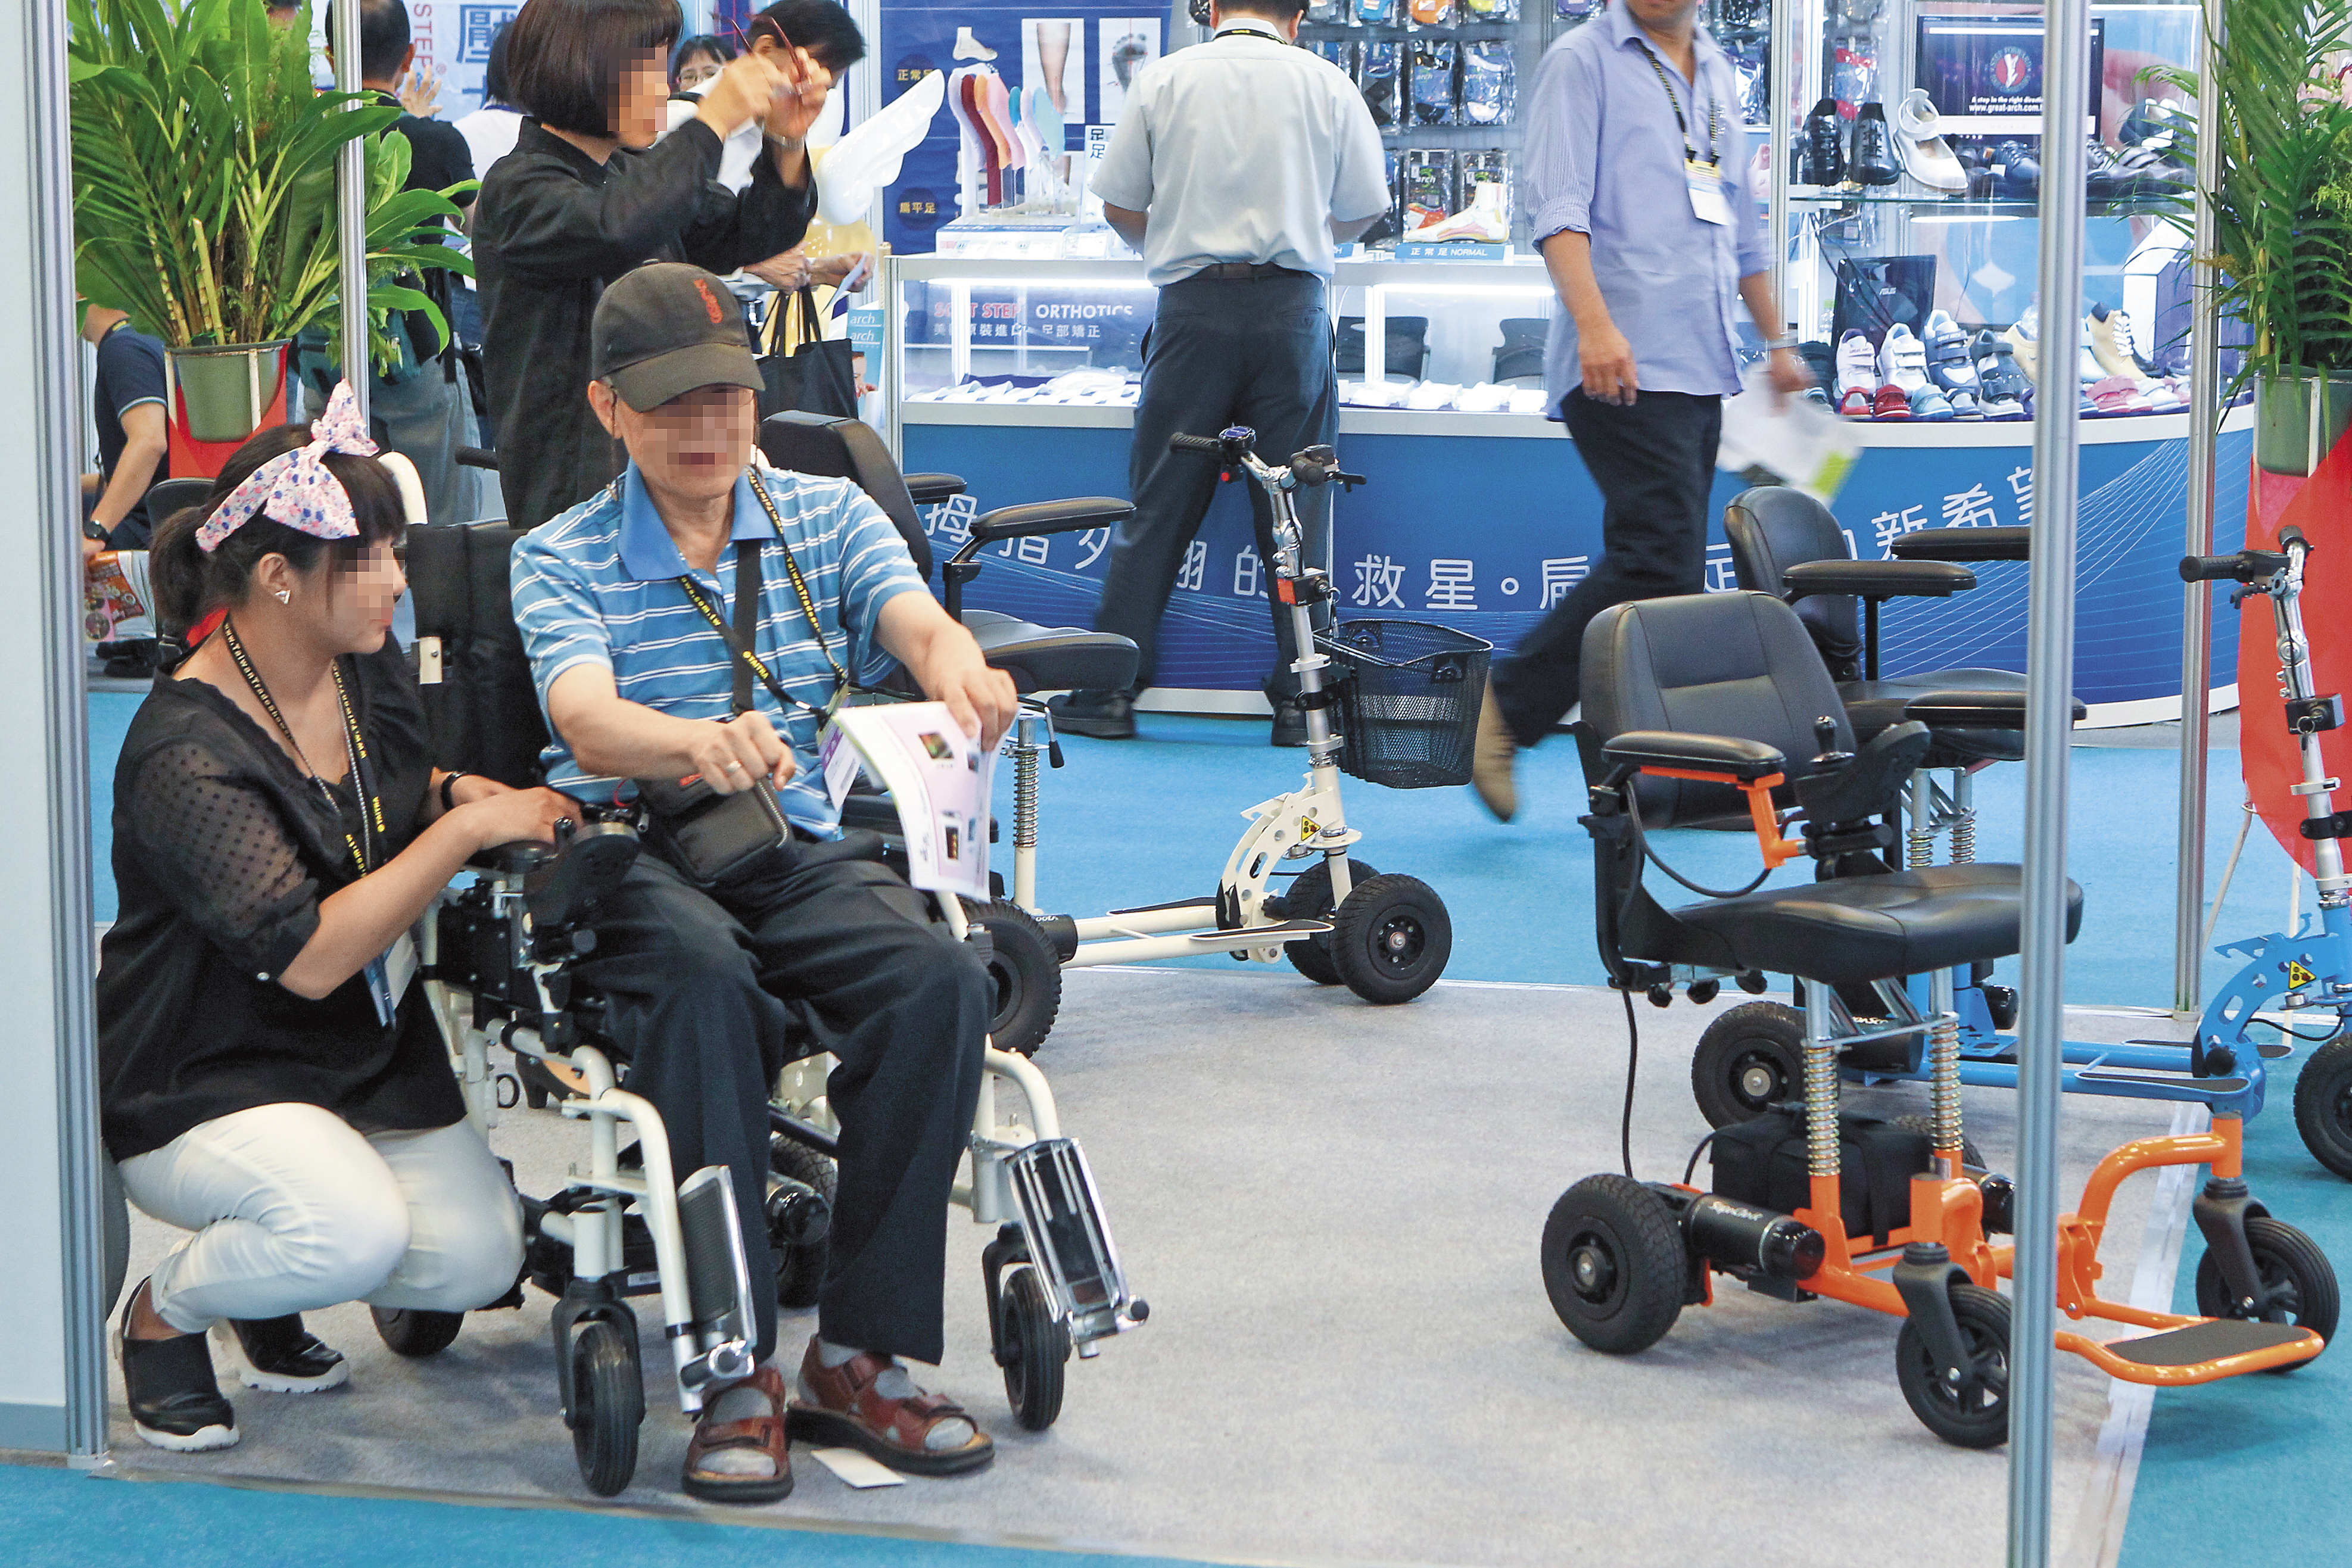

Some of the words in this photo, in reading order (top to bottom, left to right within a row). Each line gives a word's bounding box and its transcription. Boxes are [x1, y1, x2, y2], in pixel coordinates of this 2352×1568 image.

[1977, 96, 1990, 105] step
[2008, 96, 2023, 105] right
[1968, 104, 2043, 114] www.great-arch.com.t
[1450, 248, 1488, 257] NORMAL
[850, 313, 876, 324] arch
[849, 329, 874, 341] arch
